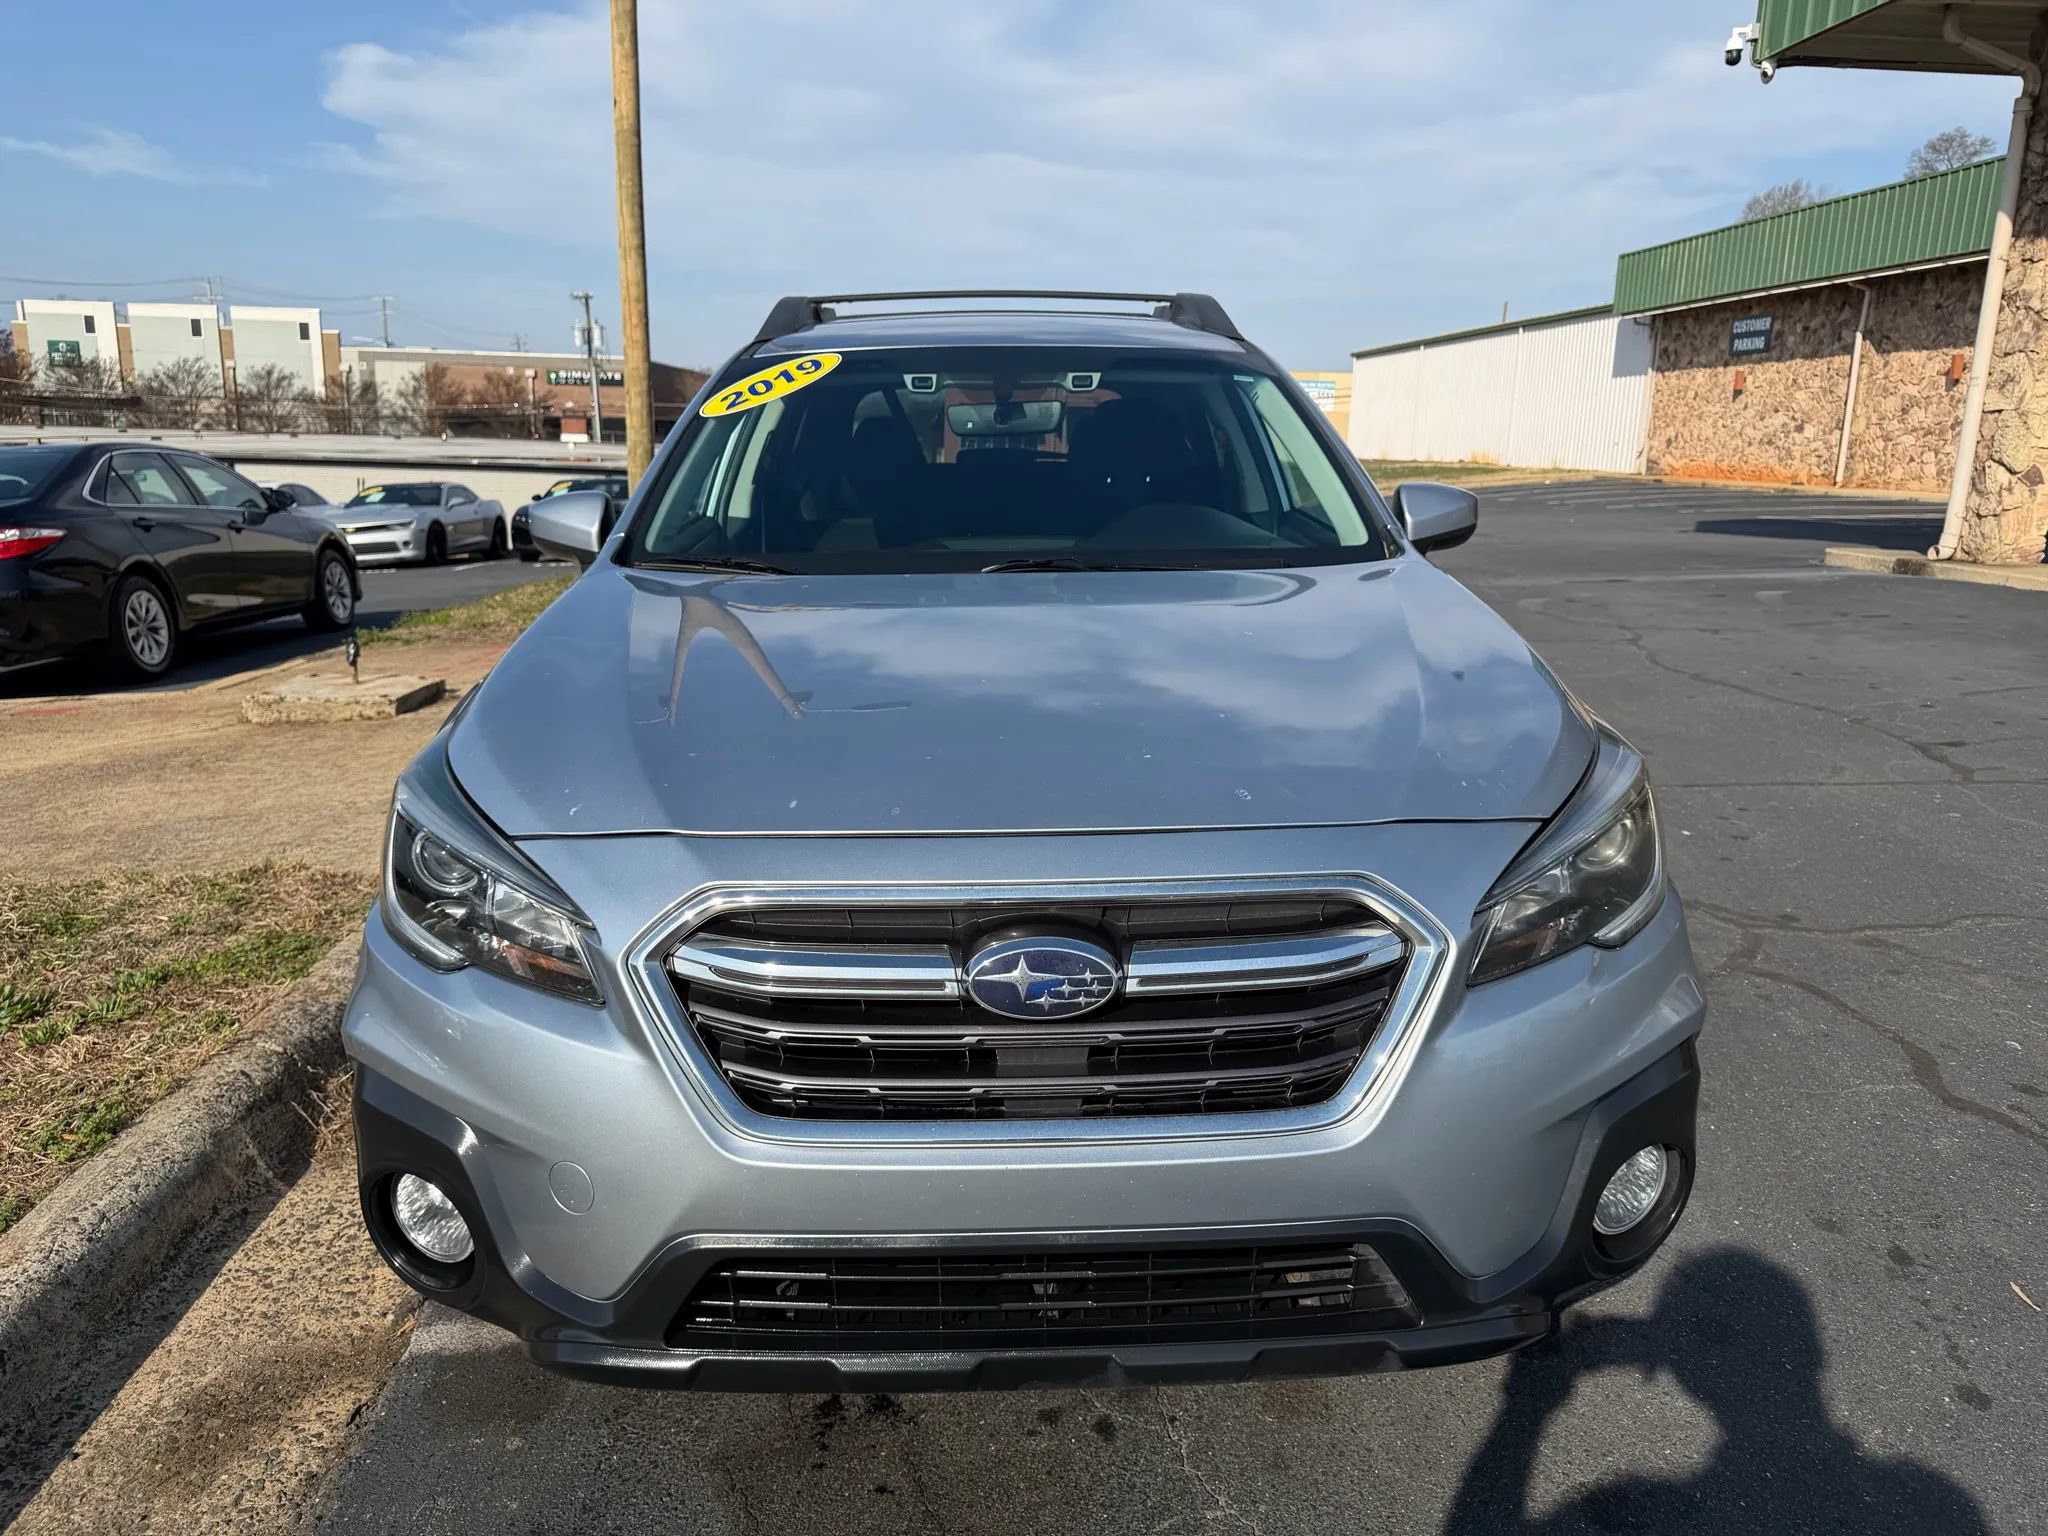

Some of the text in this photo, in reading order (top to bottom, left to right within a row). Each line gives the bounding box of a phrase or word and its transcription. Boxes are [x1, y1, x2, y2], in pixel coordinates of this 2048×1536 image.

[1733, 317, 1772, 334] CUSTOMER
[1733, 336, 1766, 352] PARKING
[559, 370, 622, 381] SIMUATE
[720, 359, 823, 411] 2019
